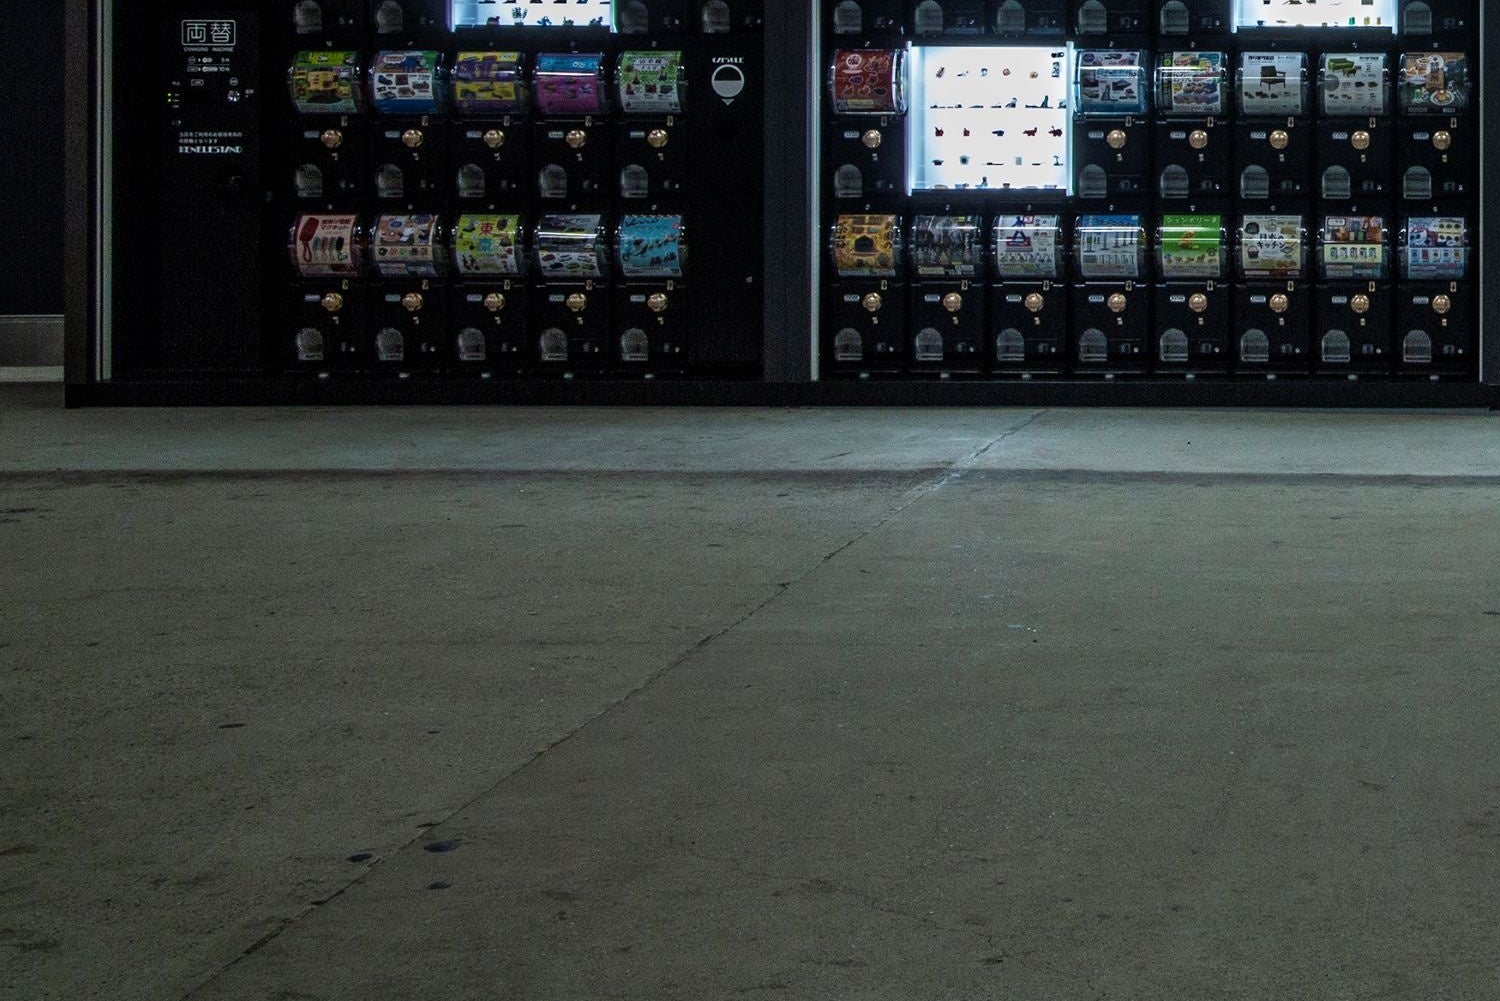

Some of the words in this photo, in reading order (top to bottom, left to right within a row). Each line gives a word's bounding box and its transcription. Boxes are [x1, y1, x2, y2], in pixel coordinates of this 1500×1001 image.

[186, 22, 232, 43] 両替
[711, 56, 745, 64] CAPSULE
[178, 145, 243, 154] KENELESTAND
